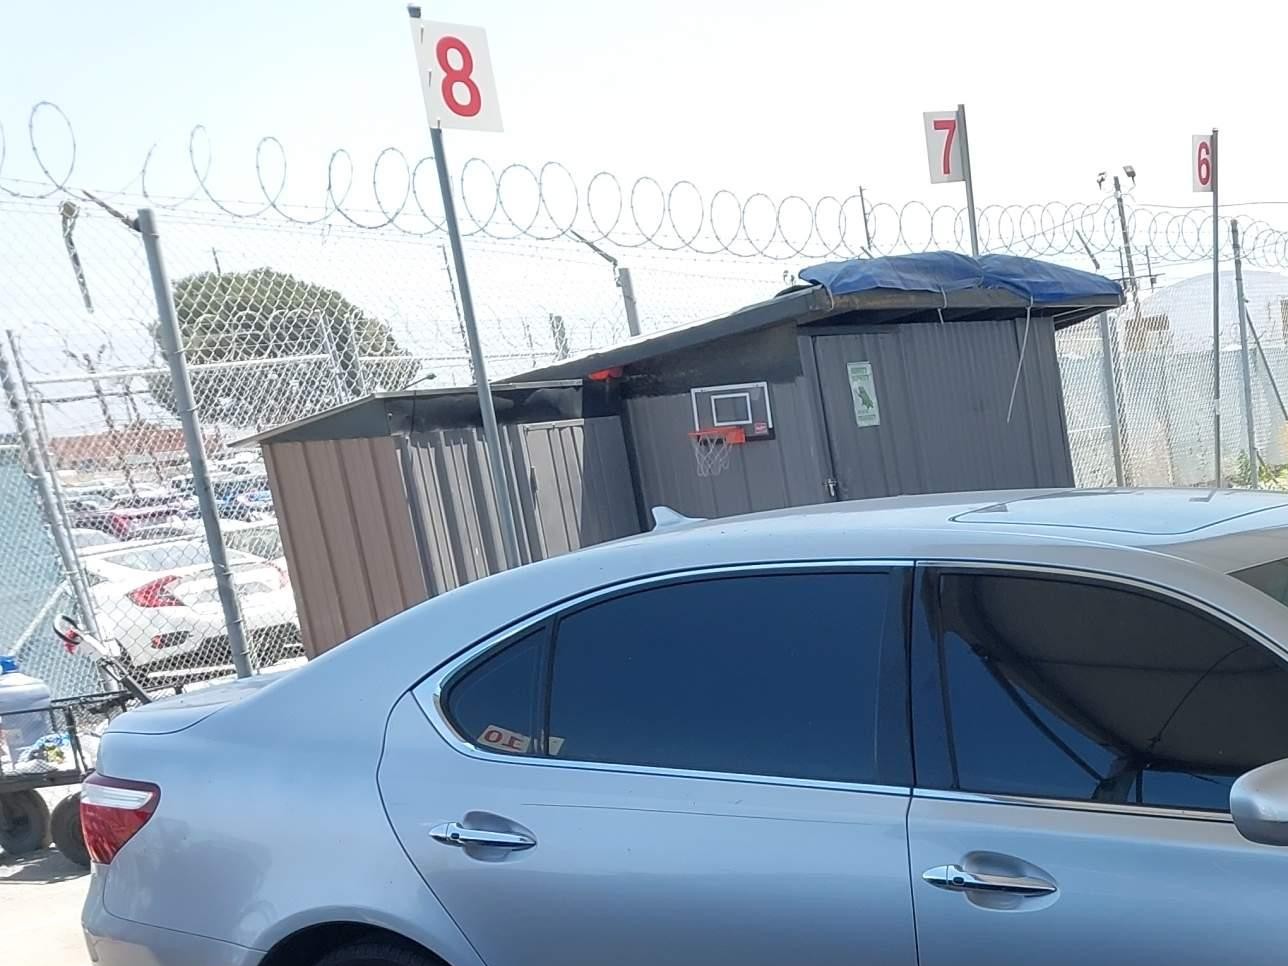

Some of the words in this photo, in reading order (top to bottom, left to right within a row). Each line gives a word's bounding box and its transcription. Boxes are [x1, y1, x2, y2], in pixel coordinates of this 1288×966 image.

[435, 35, 482, 118] 8
[932, 118, 957, 175] 7
[1196, 141, 1211, 187] 6
